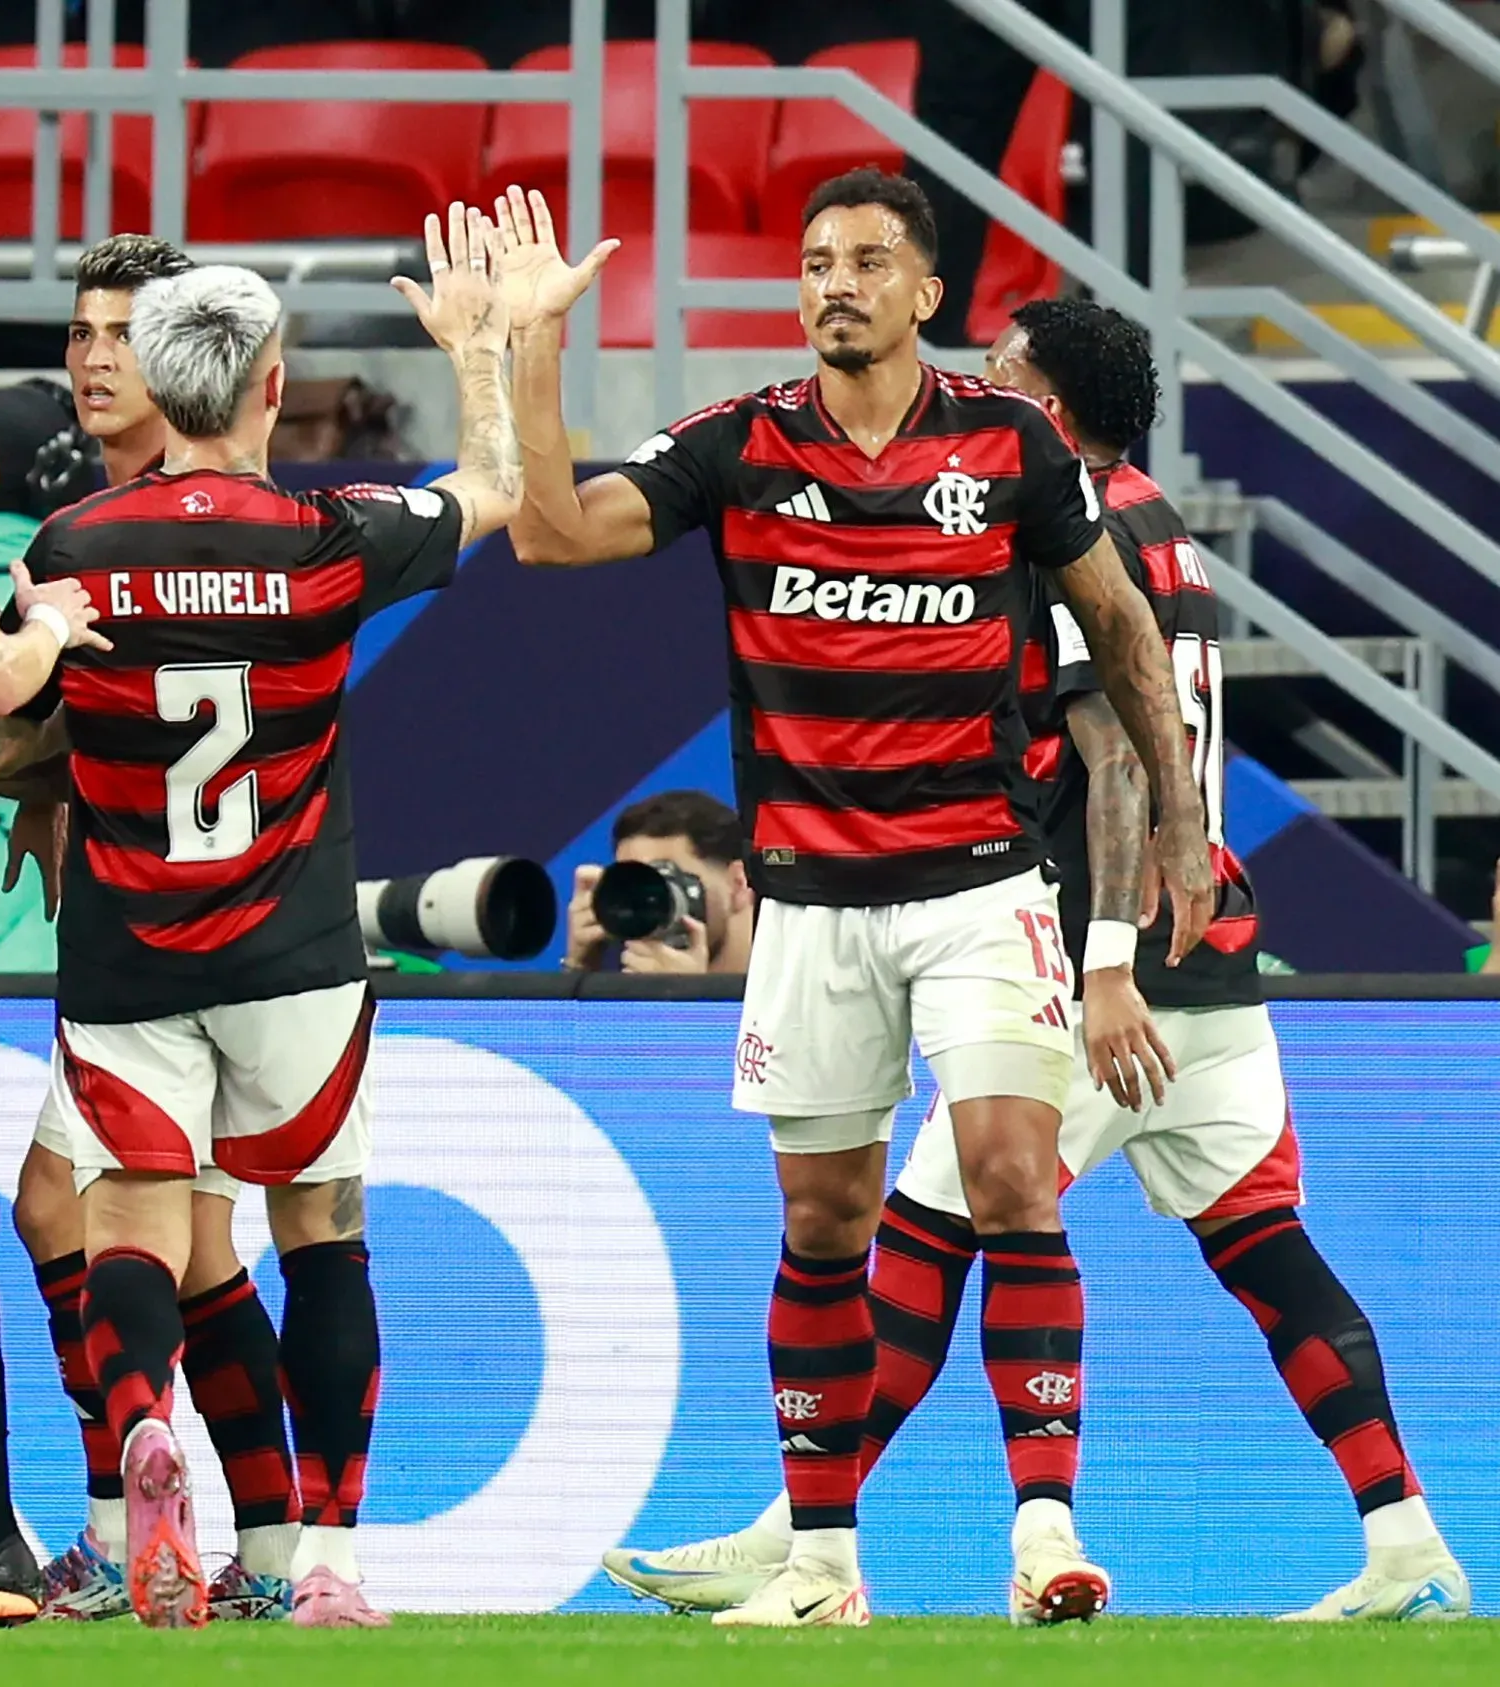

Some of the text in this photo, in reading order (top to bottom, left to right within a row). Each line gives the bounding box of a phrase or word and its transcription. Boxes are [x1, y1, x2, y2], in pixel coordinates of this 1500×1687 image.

[110, 571, 290, 616] G. VARELA
[769, 565, 975, 624] Betano
[154, 661, 260, 863] 2
[1015, 908, 1069, 989] 13
